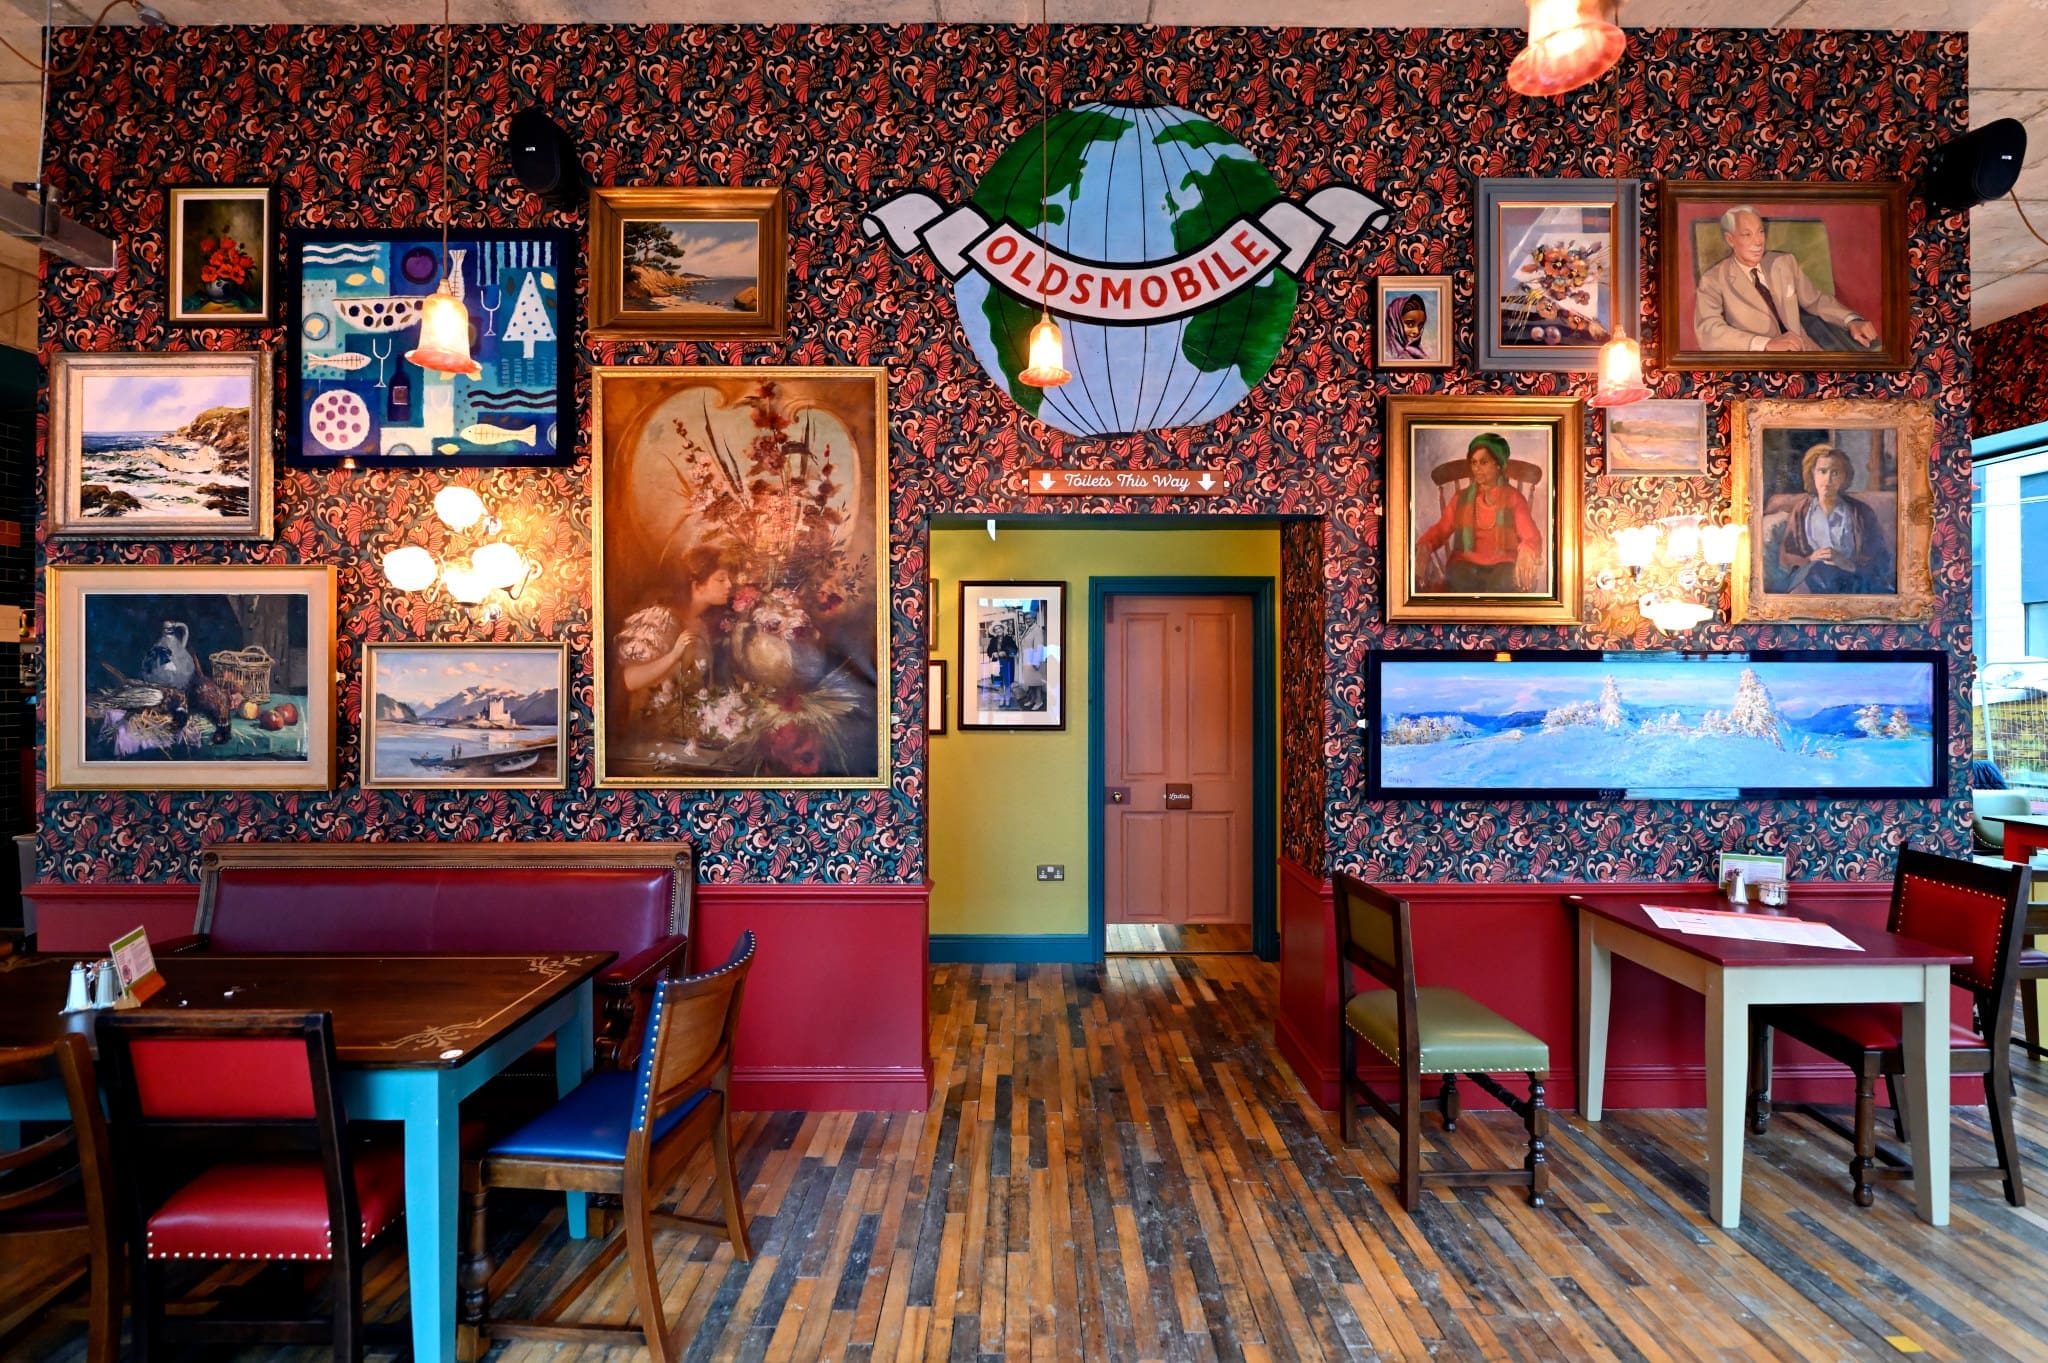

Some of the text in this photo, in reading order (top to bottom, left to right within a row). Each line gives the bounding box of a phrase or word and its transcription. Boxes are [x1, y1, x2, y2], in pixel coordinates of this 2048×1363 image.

[986, 230, 1270, 309] OLDSMOBILE
[1064, 473, 1190, 492] Toilets This Way
